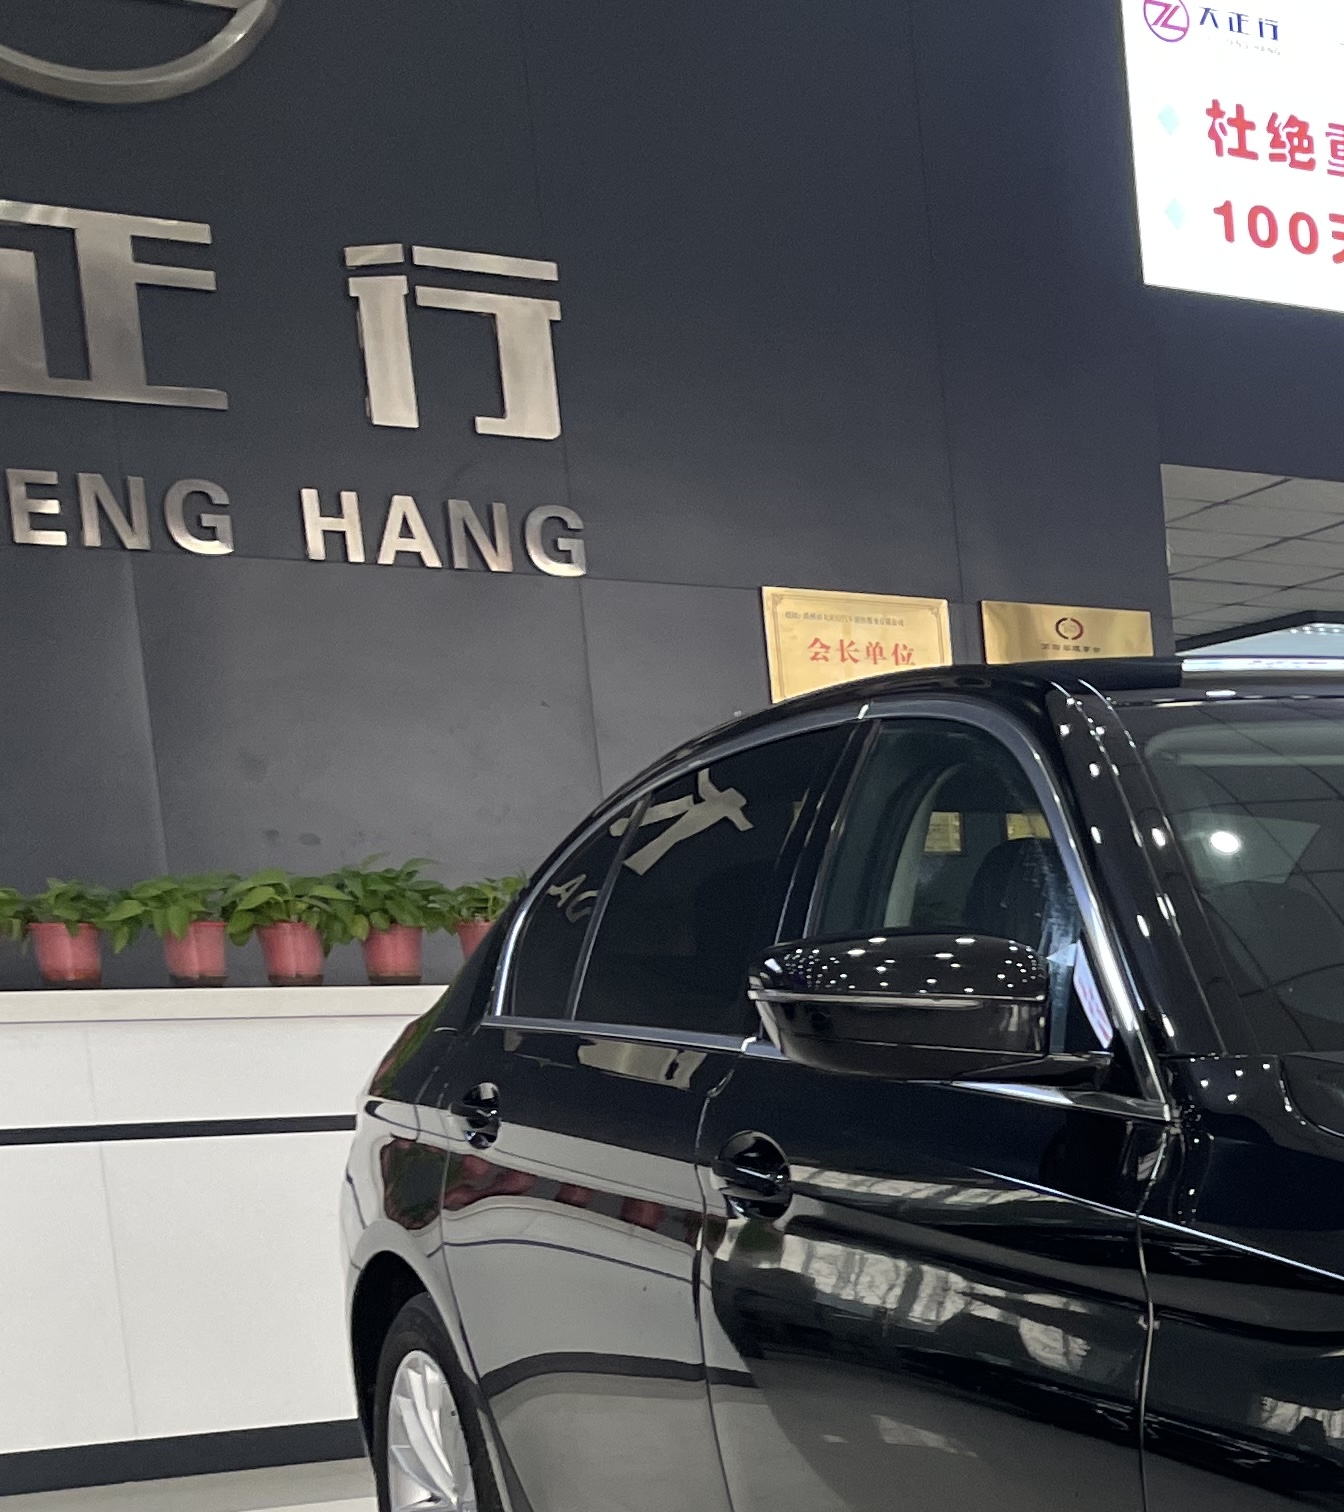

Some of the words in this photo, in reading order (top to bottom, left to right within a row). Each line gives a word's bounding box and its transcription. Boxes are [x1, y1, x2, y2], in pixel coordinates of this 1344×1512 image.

[301, 487, 588, 577] HANG
[807, 637, 916, 666] 会长单位
